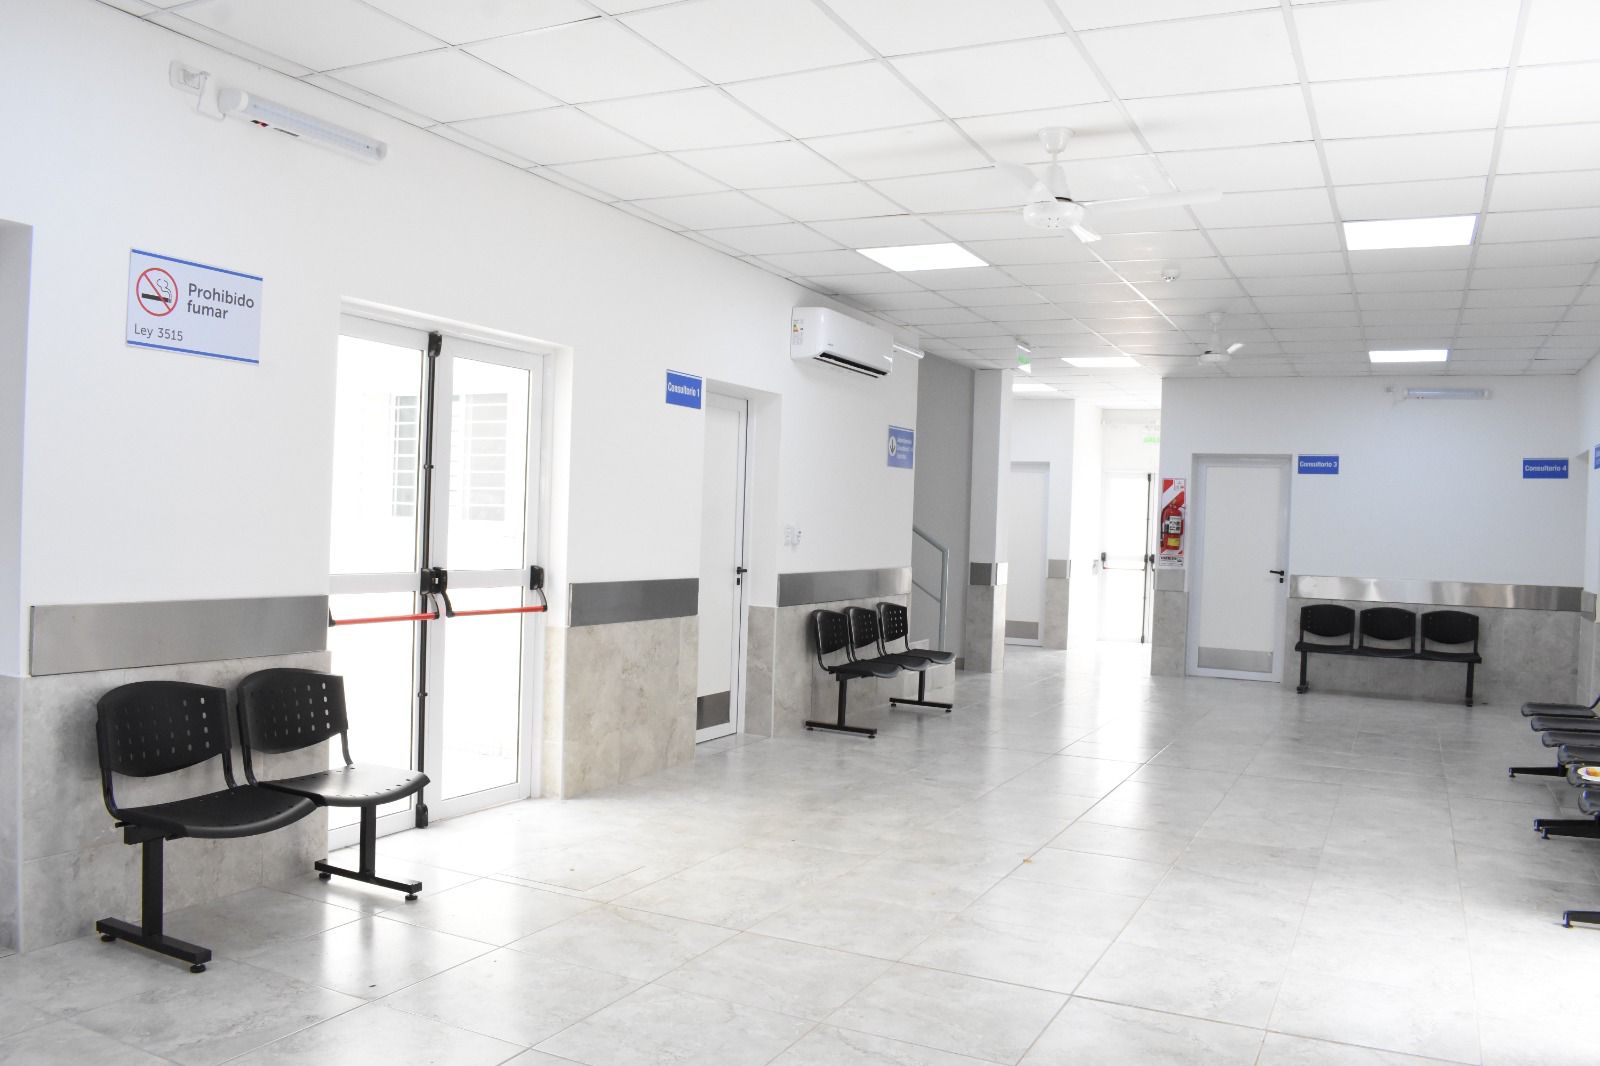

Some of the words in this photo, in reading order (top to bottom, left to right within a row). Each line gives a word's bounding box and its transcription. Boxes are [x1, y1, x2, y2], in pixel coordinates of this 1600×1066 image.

[188, 282, 255, 309] Prohibido
[187, 299, 228, 320] fumar
[134, 323, 154, 339] Ley
[158, 327, 184, 342] 3515
[667, 382, 696, 397] Consultorio
[1525, 464, 1561, 472] Consultorio
